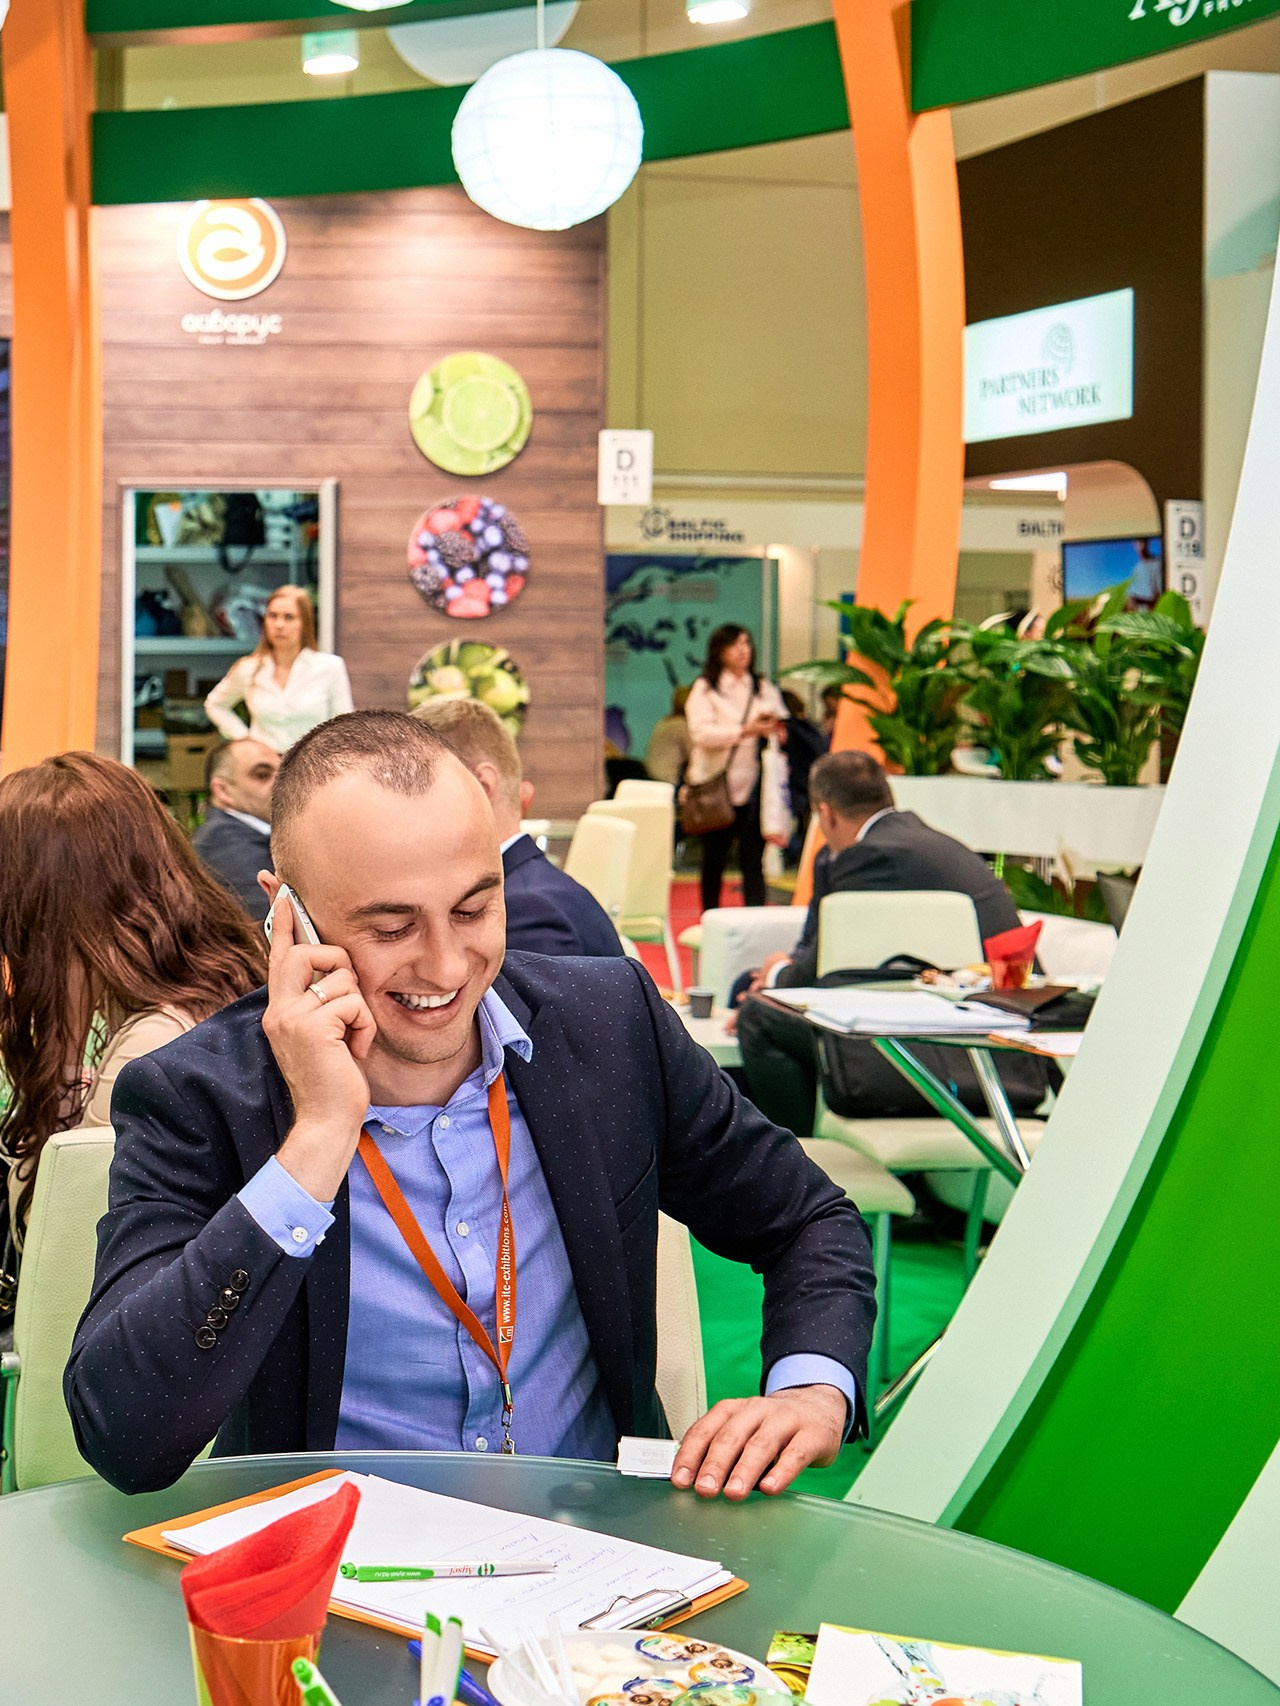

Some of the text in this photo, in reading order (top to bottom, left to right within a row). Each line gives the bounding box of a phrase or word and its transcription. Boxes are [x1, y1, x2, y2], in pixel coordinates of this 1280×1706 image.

[978, 367, 1060, 398] PARTNERS
[1018, 382, 1103, 414] NETWORK
[616, 449, 634, 471] D
[1018, 517, 1064, 537] BALTI
[1180, 516, 1196, 540] D
[1181, 572, 1197, 596] D
